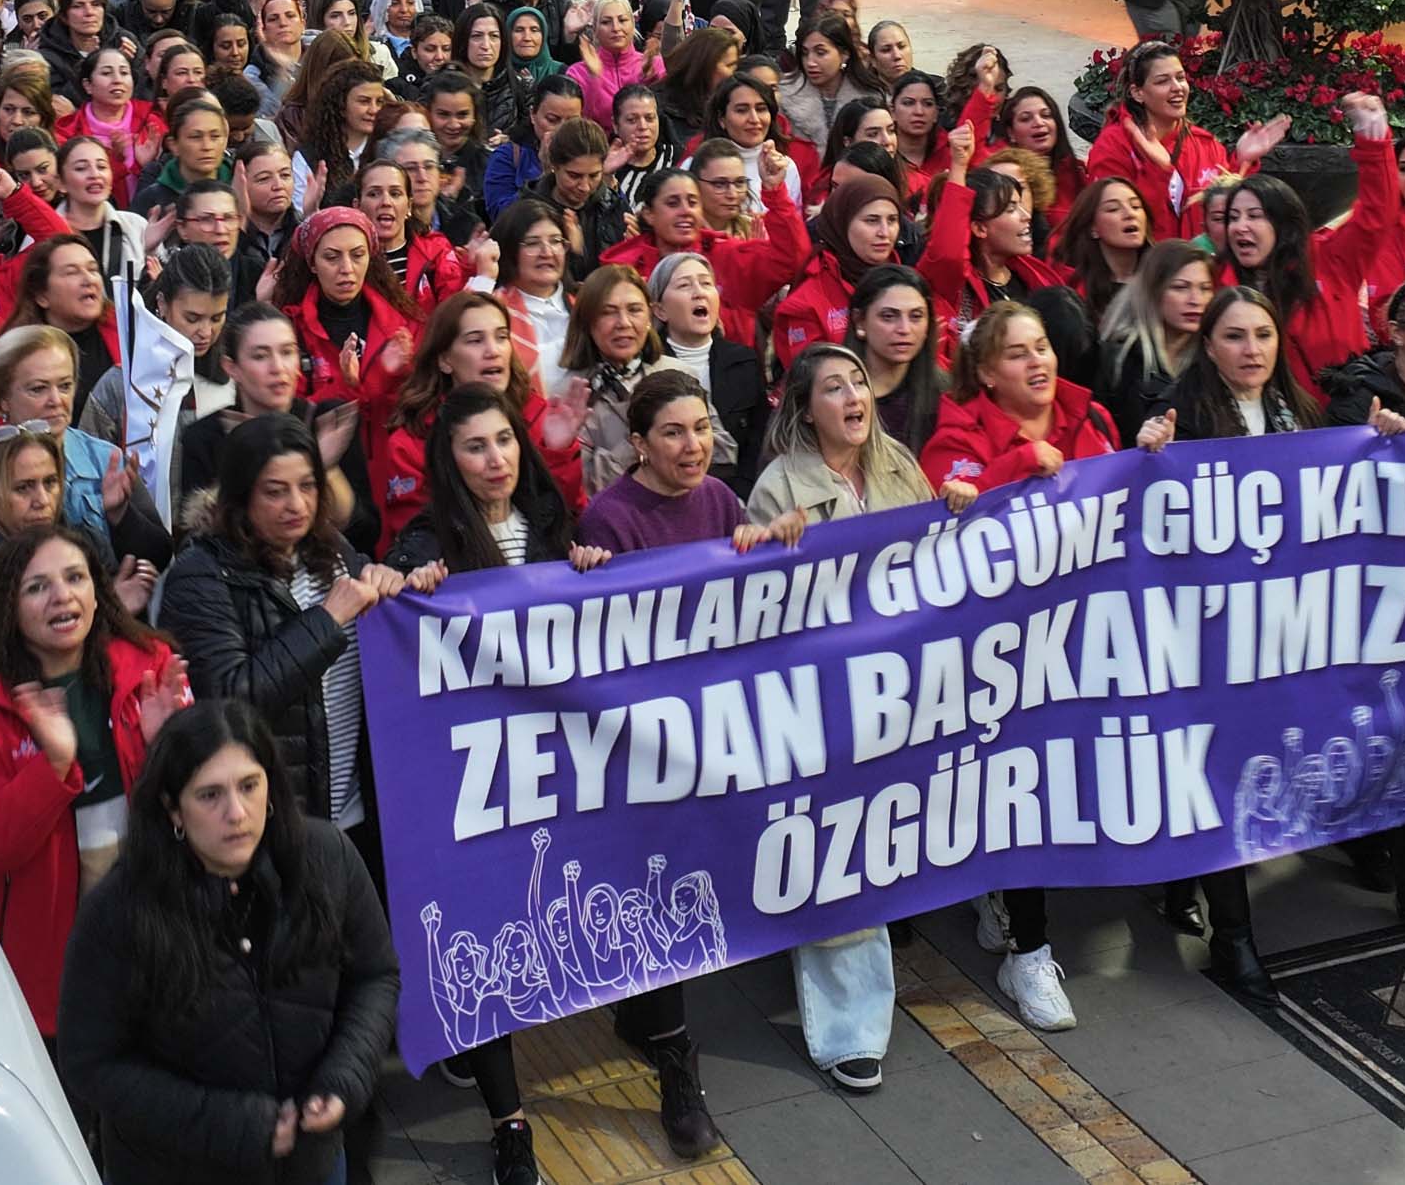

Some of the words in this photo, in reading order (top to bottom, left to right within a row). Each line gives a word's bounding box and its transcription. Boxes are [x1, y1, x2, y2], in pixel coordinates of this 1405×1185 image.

[417, 551, 854, 698] KADINLARIN
[867, 486, 1130, 618] GÜCÜNE
[1142, 460, 1285, 566] GÜÇ
[449, 663, 828, 843] ZEYDAN
[751, 714, 1225, 916] ÖZGÜRLÜK
